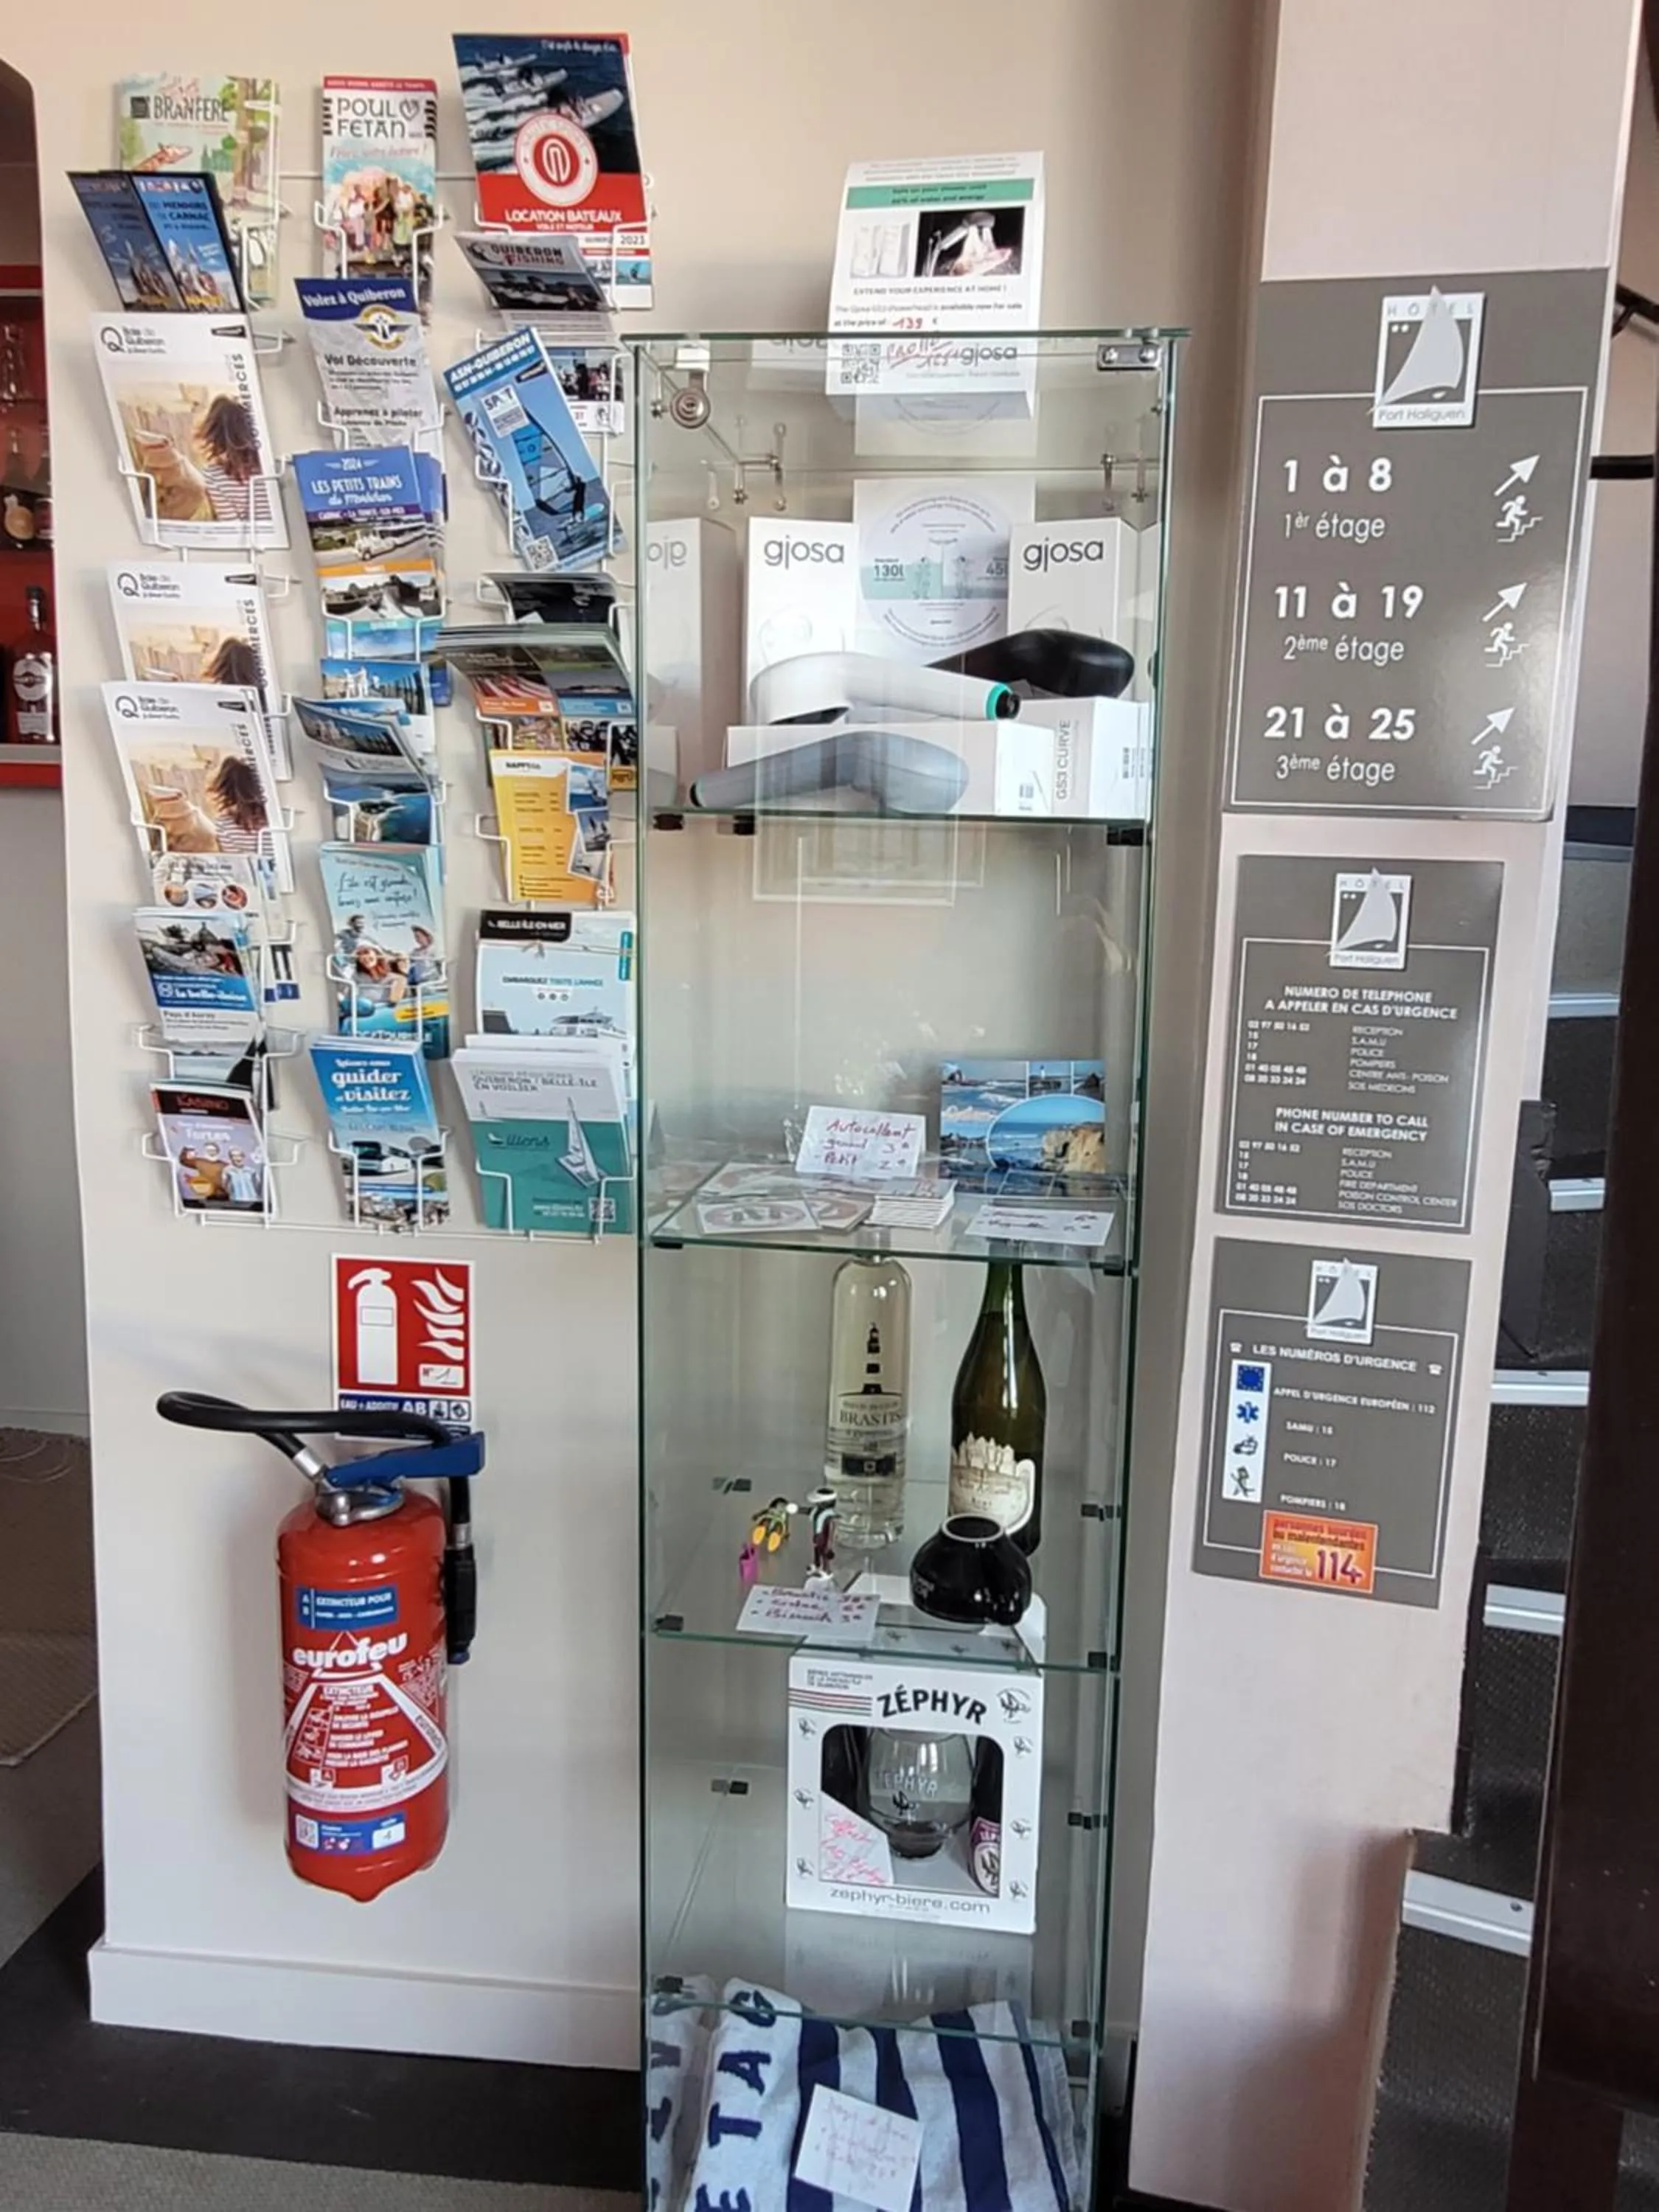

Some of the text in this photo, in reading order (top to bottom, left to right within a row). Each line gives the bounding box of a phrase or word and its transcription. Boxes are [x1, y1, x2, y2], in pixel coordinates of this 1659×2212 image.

[337, 97, 397, 117] POUL
[337, 119, 405, 138] FETAN
[505, 209, 622, 222] LOCATION BATEAUX
[302, 288, 406, 307] Volez à Quiberon
[324, 354, 417, 367] Vol Découverte
[960, 346, 1018, 367] gjosa
[484, 388, 512, 411] SPT
[1408, 407, 1466, 422] Haliguen
[1283, 454, 1393, 493] 1 à 8
[310, 475, 402, 494] LES PETITS TRAINS
[1315, 512, 1385, 543] étage
[763, 535, 845, 570] gjosa
[1022, 536, 1105, 572] gjosa
[1274, 582, 1424, 619] 11 à 19
[1284, 633, 1405, 667] 2ème étage
[1264, 703, 1416, 740] 21 à 25
[1059, 719, 1071, 768] CURVE
[1276, 755, 1396, 787] 3ème étage
[1284, 985, 1433, 1004] NUMERO DE TELEPHONE
[1265, 999, 1458, 1020] A APPELER EN CAS D'URGENCE
[1350, 1048, 1384, 1057] POLICE
[332, 1069, 402, 1088] guider
[344, 1087, 411, 1102] visitez
[1276, 1107, 1428, 1127] PHONE NUMBER TO CALL
[826, 1119, 917, 1140] Autocollant
[1275, 1121, 1427, 1141] IN CASE OF EMERGENCY
[1253, 1343, 1418, 1372] LES NUMÉROS D'URGENCE
[1273, 1387, 1301, 1398] APPEL
[1303, 1388, 1358, 1405] D'URGENCE
[1418, 1404, 1436, 1415] 112
[1284, 1453, 1337, 1468] POLICE 17
[1280, 1494, 1326, 1509] POMPIERS
[1317, 1549, 1363, 1584] 114
[368, 1592, 392, 1605] POUR
[292, 1632, 407, 1669] eurofeu
[877, 1685, 987, 1725] ZÉPHYR
[830, 1886, 991, 1914] zephyr-biere.com
